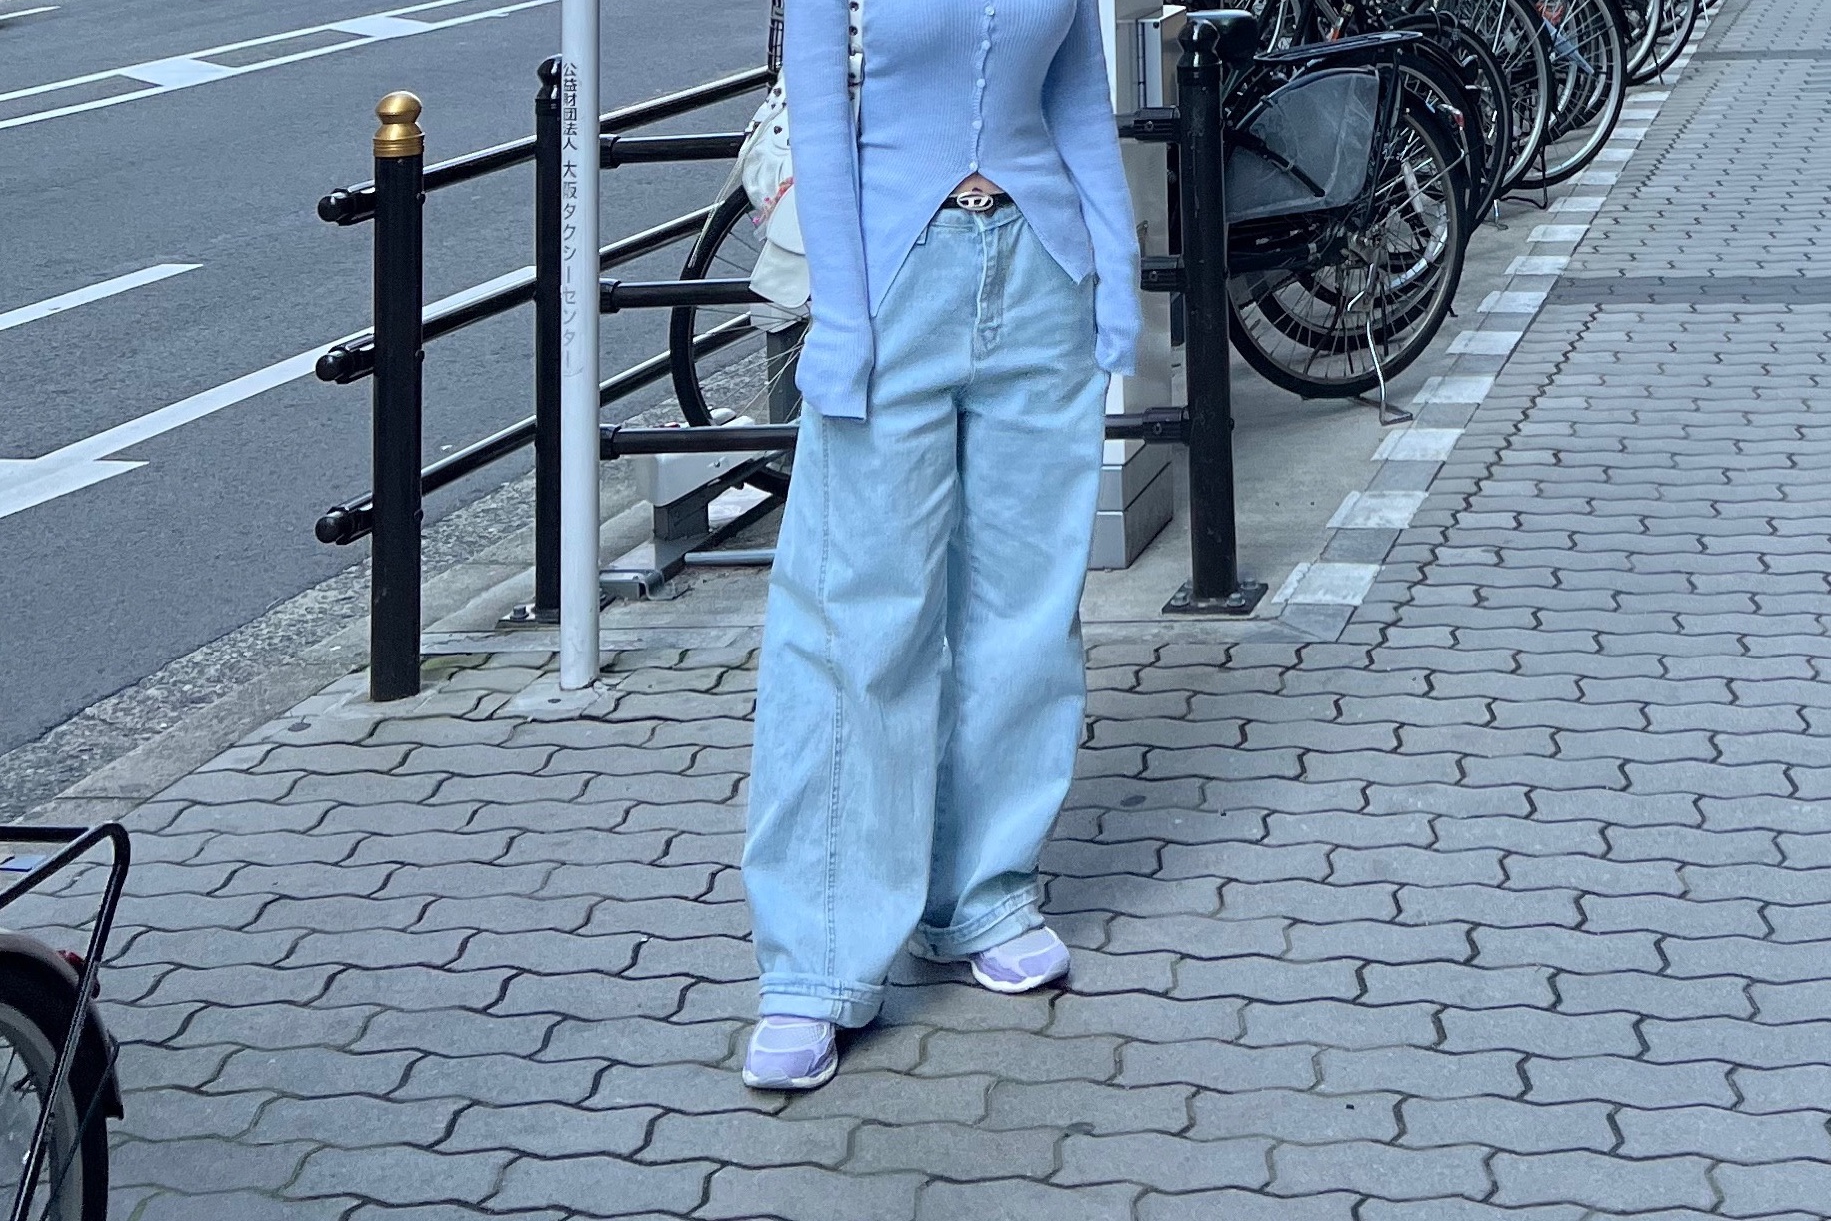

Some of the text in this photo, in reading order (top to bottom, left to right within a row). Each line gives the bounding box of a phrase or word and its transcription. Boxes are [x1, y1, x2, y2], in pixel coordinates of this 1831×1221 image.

[562, 62, 578, 369] 公益財団法人 大阪タクシーセンター
